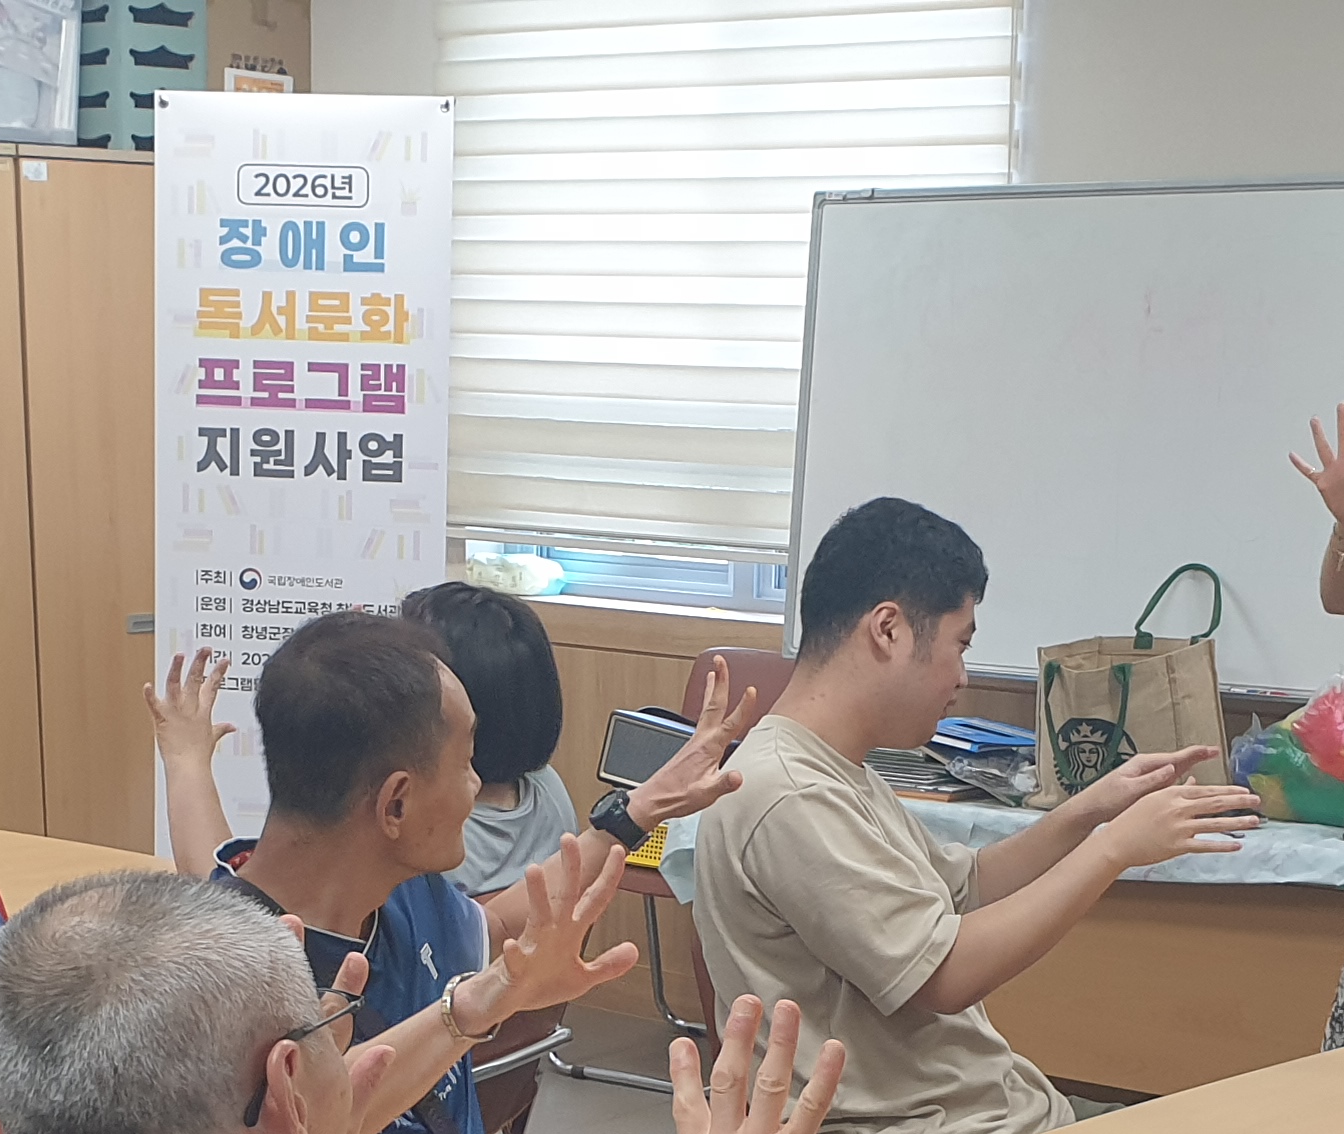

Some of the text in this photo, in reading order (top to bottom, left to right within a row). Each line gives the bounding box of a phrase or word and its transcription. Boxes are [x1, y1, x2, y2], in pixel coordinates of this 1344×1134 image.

[253, 172, 354, 201] 2026년
[218, 218, 386, 273] 장애인
[196, 287, 410, 344] 독서문화
[195, 358, 406, 415] 프로그램
[196, 426, 404, 483] 지원사업
[241, 597, 332, 616] 경상남도교육청
[267, 575, 344, 589] 국립장애인도서관
